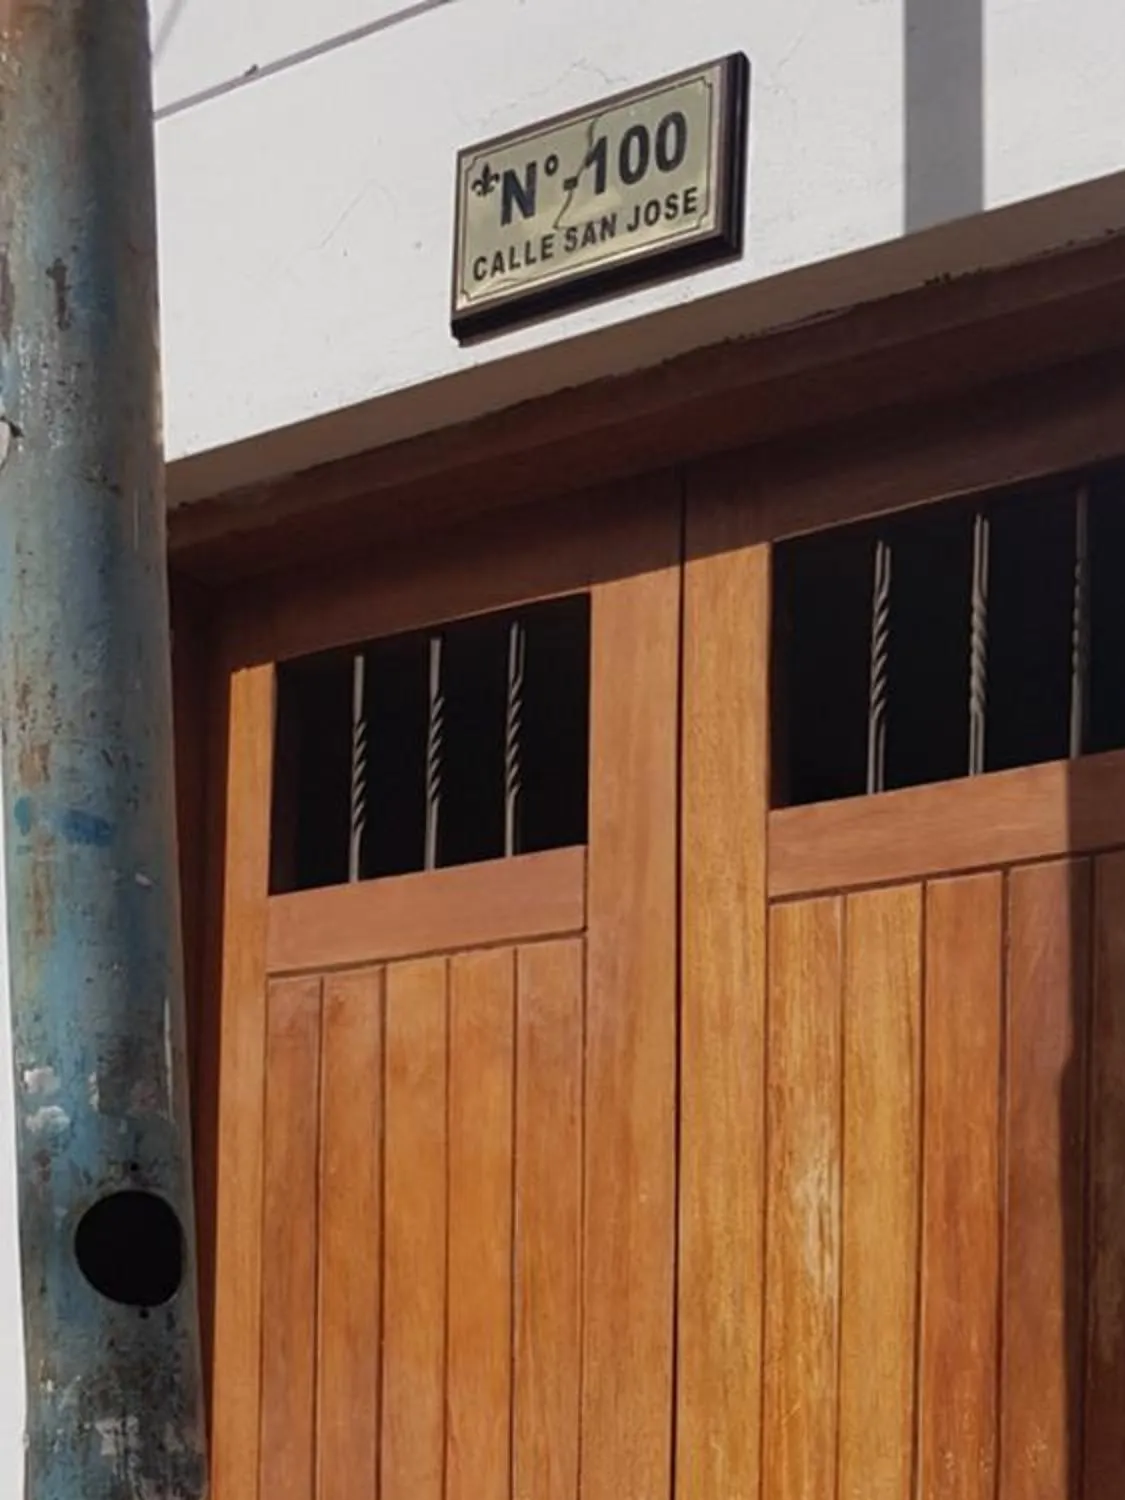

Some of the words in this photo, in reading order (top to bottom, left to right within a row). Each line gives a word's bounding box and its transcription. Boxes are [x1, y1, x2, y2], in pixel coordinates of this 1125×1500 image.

[473, 233, 554, 281] CALLE
[565, 213, 616, 252] SAN
[627, 187, 698, 232] JOSE
